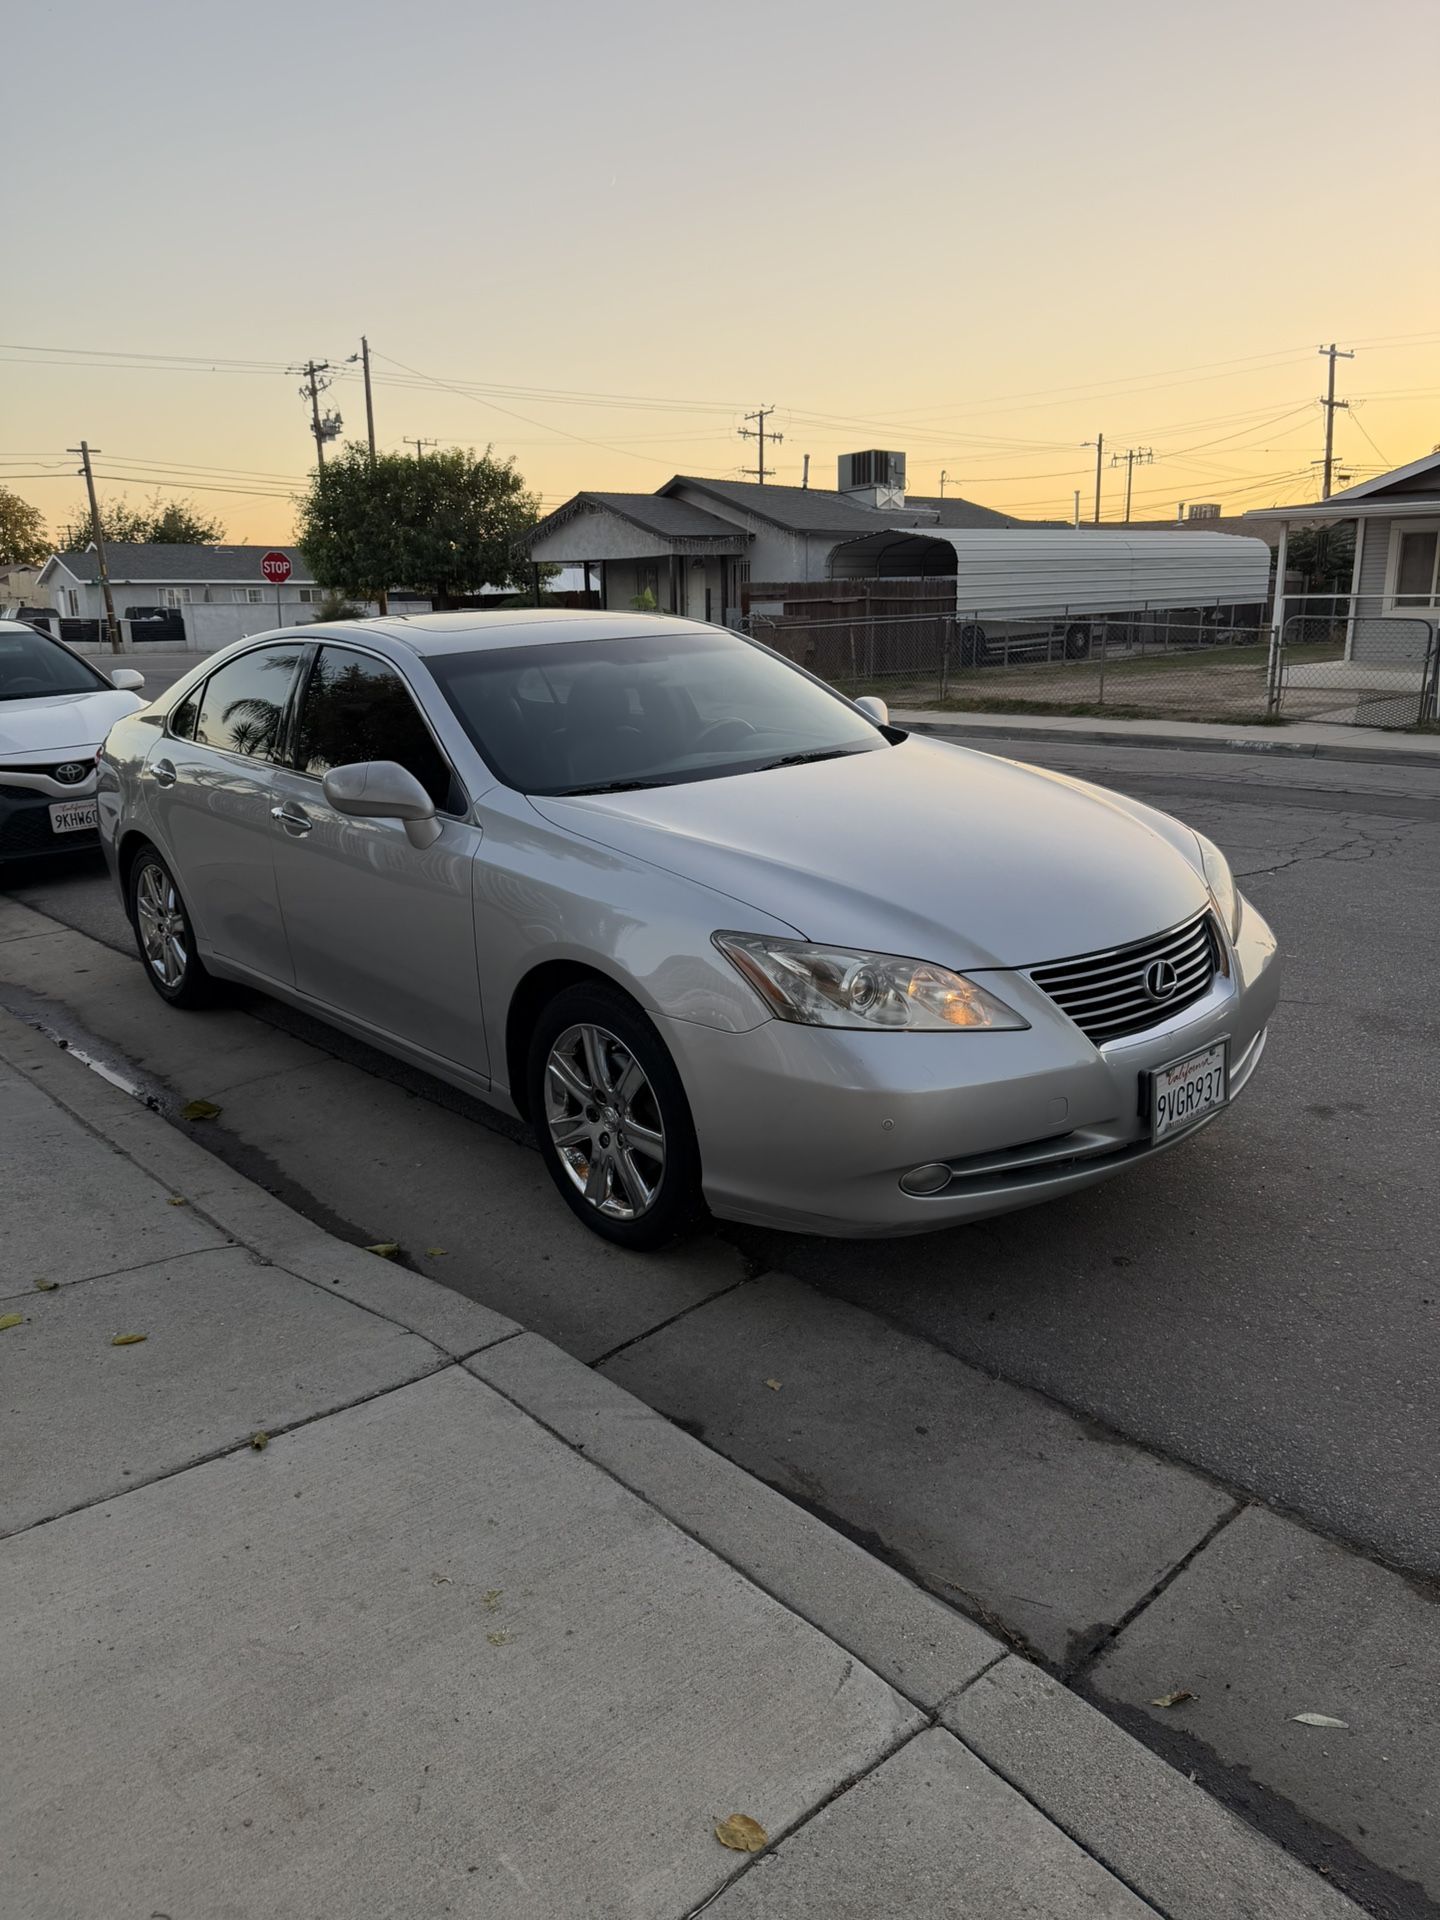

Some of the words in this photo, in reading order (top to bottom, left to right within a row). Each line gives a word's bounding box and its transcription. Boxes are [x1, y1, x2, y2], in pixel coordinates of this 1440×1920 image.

[263, 561, 290, 573] STOP
[1168, 1058, 1213, 1085] California
[1157, 1067, 1222, 1128] 9VGR937
